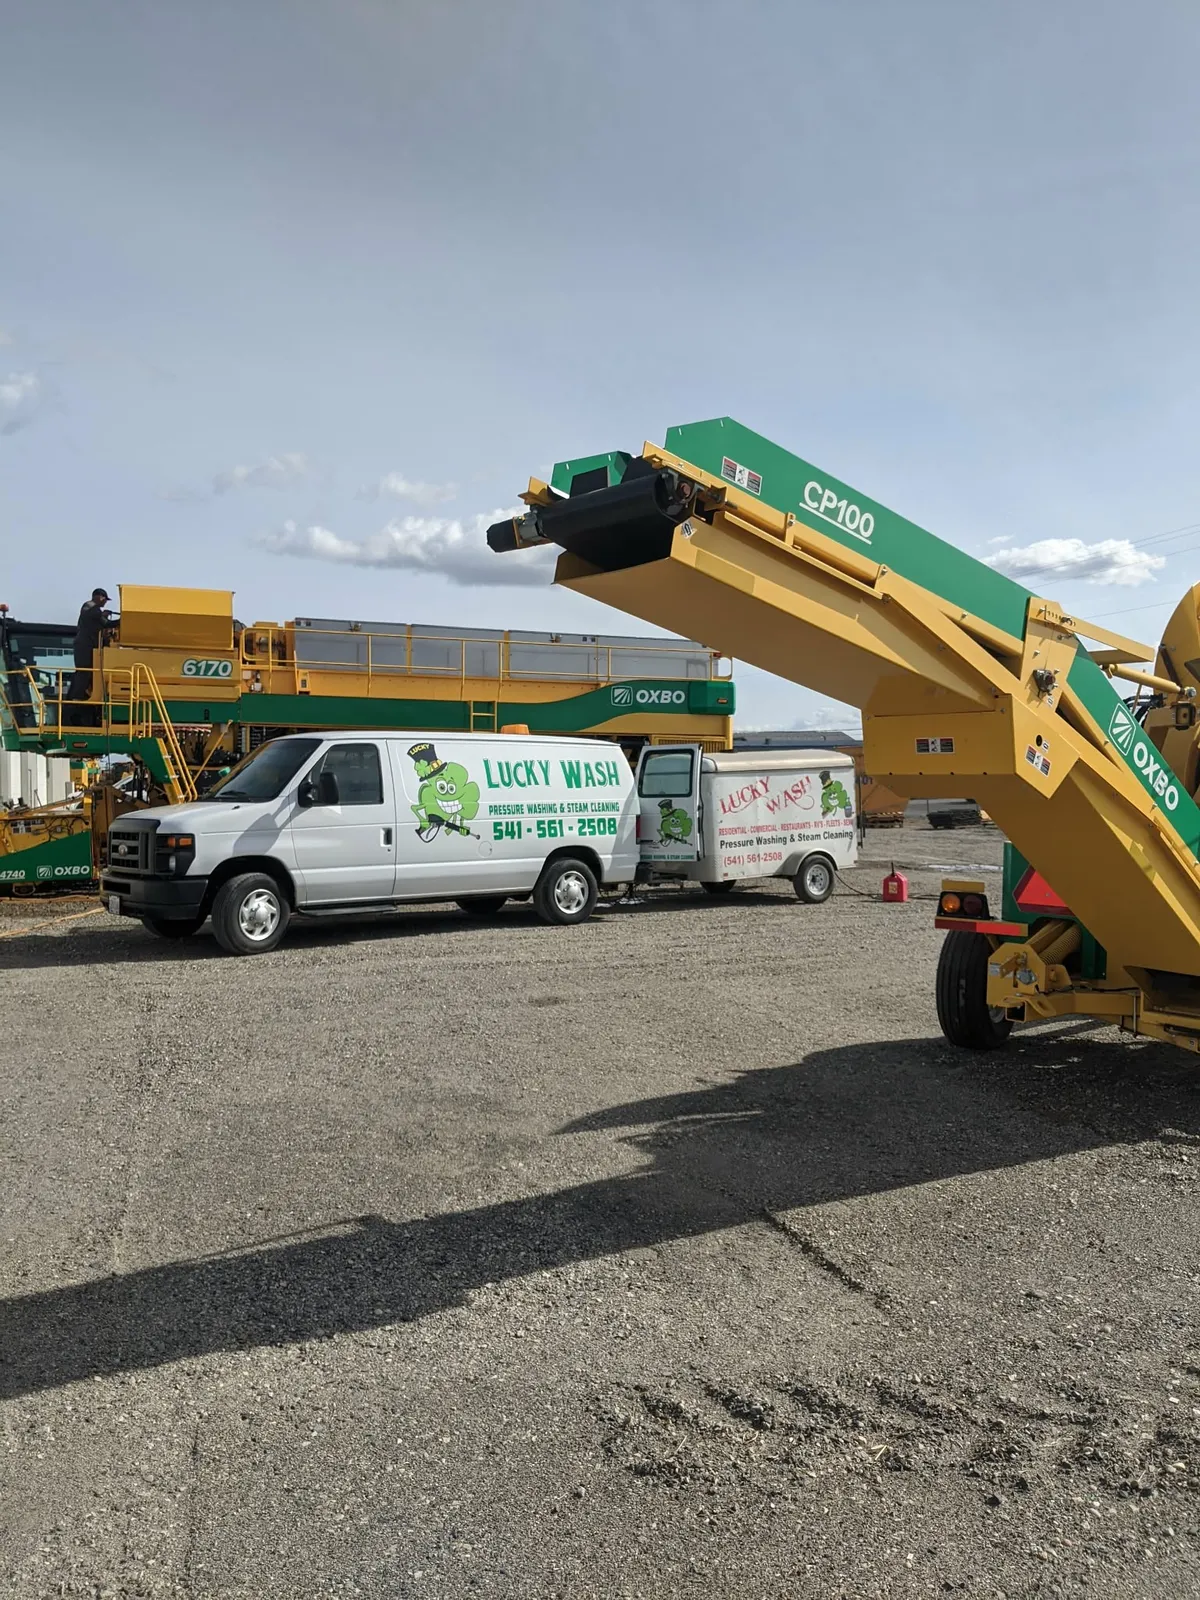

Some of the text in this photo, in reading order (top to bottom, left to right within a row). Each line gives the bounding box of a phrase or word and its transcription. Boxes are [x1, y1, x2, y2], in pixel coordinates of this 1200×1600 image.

[804, 481, 875, 538] CP100
[183, 660, 232, 677] 6170
[636, 690, 686, 704] OXBO
[410, 744, 429, 755] LUCKY
[483, 758, 620, 789] LUCKY WASH
[1133, 742, 1179, 811] OXBO
[720, 776, 814, 815] LUCKY WASH
[488, 801, 620, 816] PRESSURE WASHING & STEAM CLEANING
[719, 826, 747, 836] RESIDENTIAL
[720, 829, 853, 849] Pressure Washing & Steam Cleaning
[724, 851, 783, 867] (541) 561-2508
[54, 865, 90, 876] OXBO
